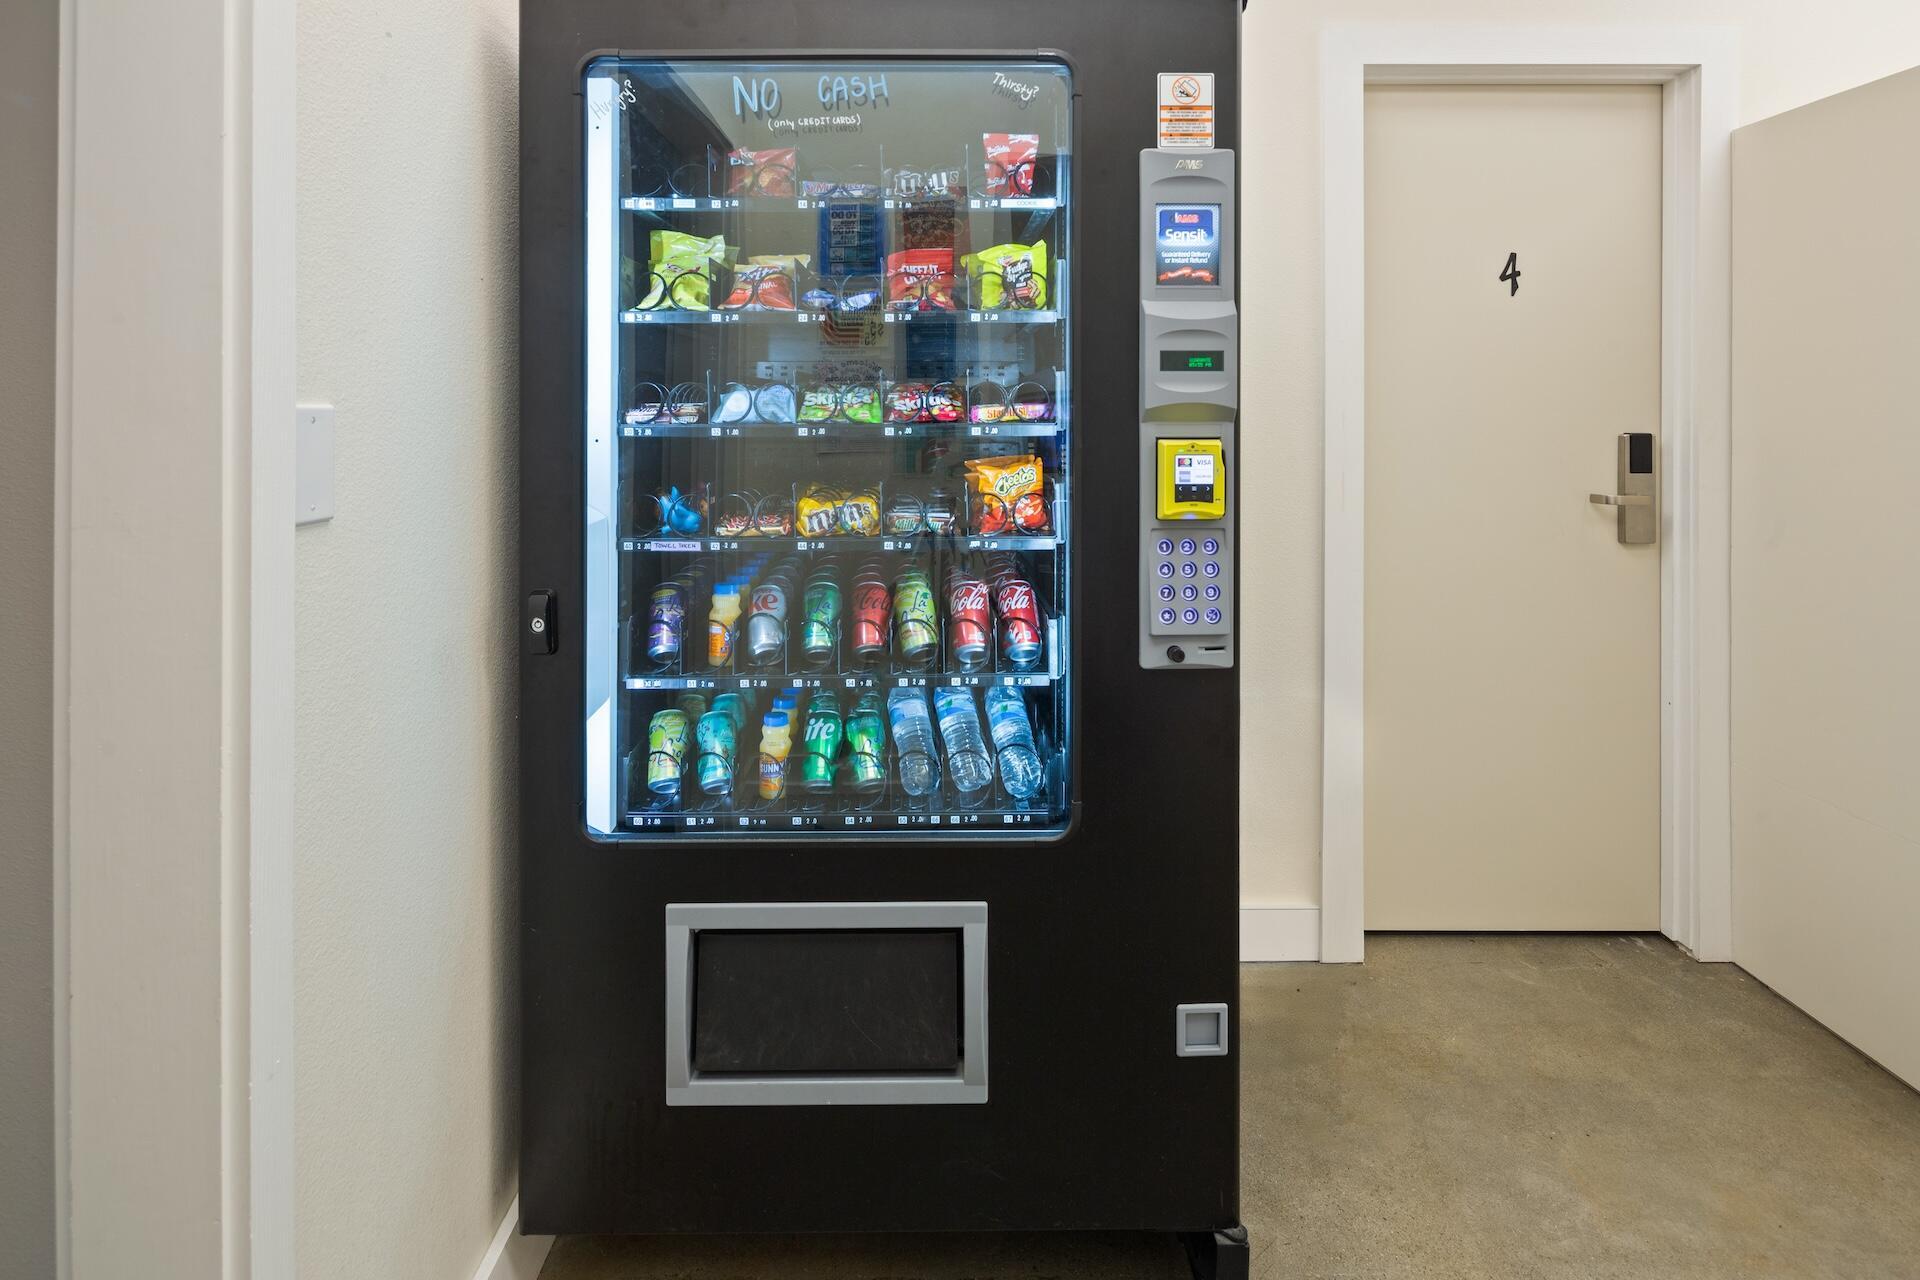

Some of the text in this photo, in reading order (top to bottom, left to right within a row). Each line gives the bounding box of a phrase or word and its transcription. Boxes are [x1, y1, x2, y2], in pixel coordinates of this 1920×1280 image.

[733, 74, 888, 115] NO CASH
[993, 72, 1039, 101] Thirsty?
[767, 113, 861, 131] (only CREDIT CARDS)
[1165, 228, 1208, 241] Sensit
[1499, 252, 1521, 297] 4
[803, 389, 872, 409] Skitles
[893, 389, 962, 411] Skitles
[909, 590, 929, 612] La
[951, 583, 985, 614] Cola
[805, 717, 836, 742] ite
